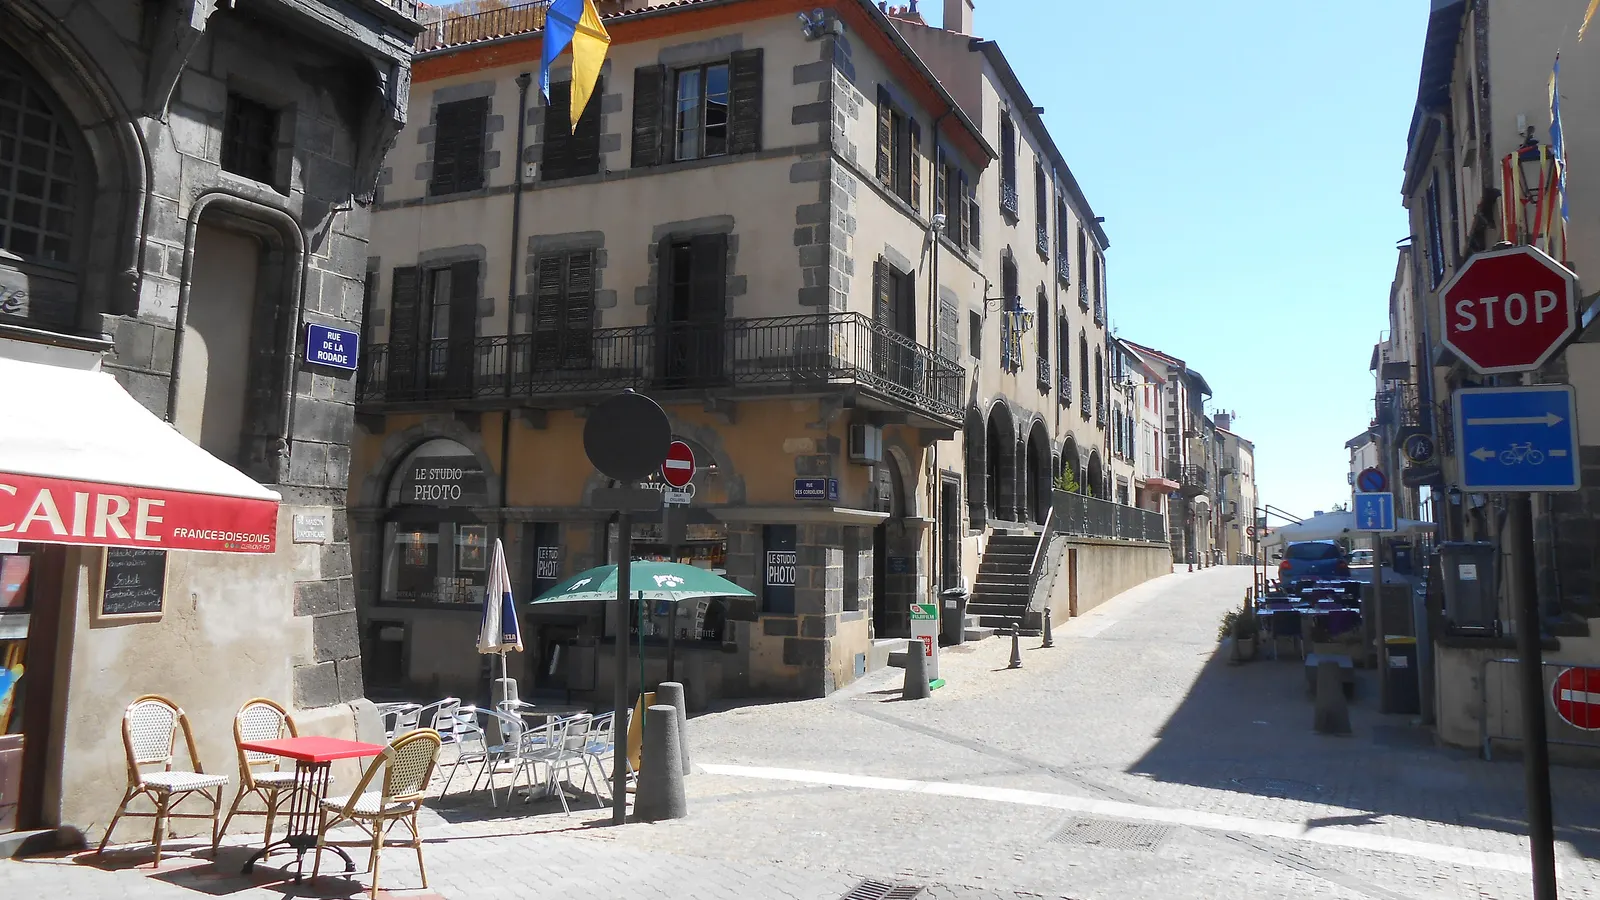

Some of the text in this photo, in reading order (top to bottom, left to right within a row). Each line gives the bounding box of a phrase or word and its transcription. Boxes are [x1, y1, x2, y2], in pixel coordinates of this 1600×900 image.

[1454, 289, 1558, 332] STOP
[327, 331, 341, 341] RUE
[323, 341, 344, 352] DE LA
[317, 350, 348, 364] RODADE
[415, 468, 463, 480] LE STUDIO
[414, 484, 461, 500] PHOTO
[769, 554, 797, 565] LE STUDIO
[769, 565, 797, 584] PHOTO
